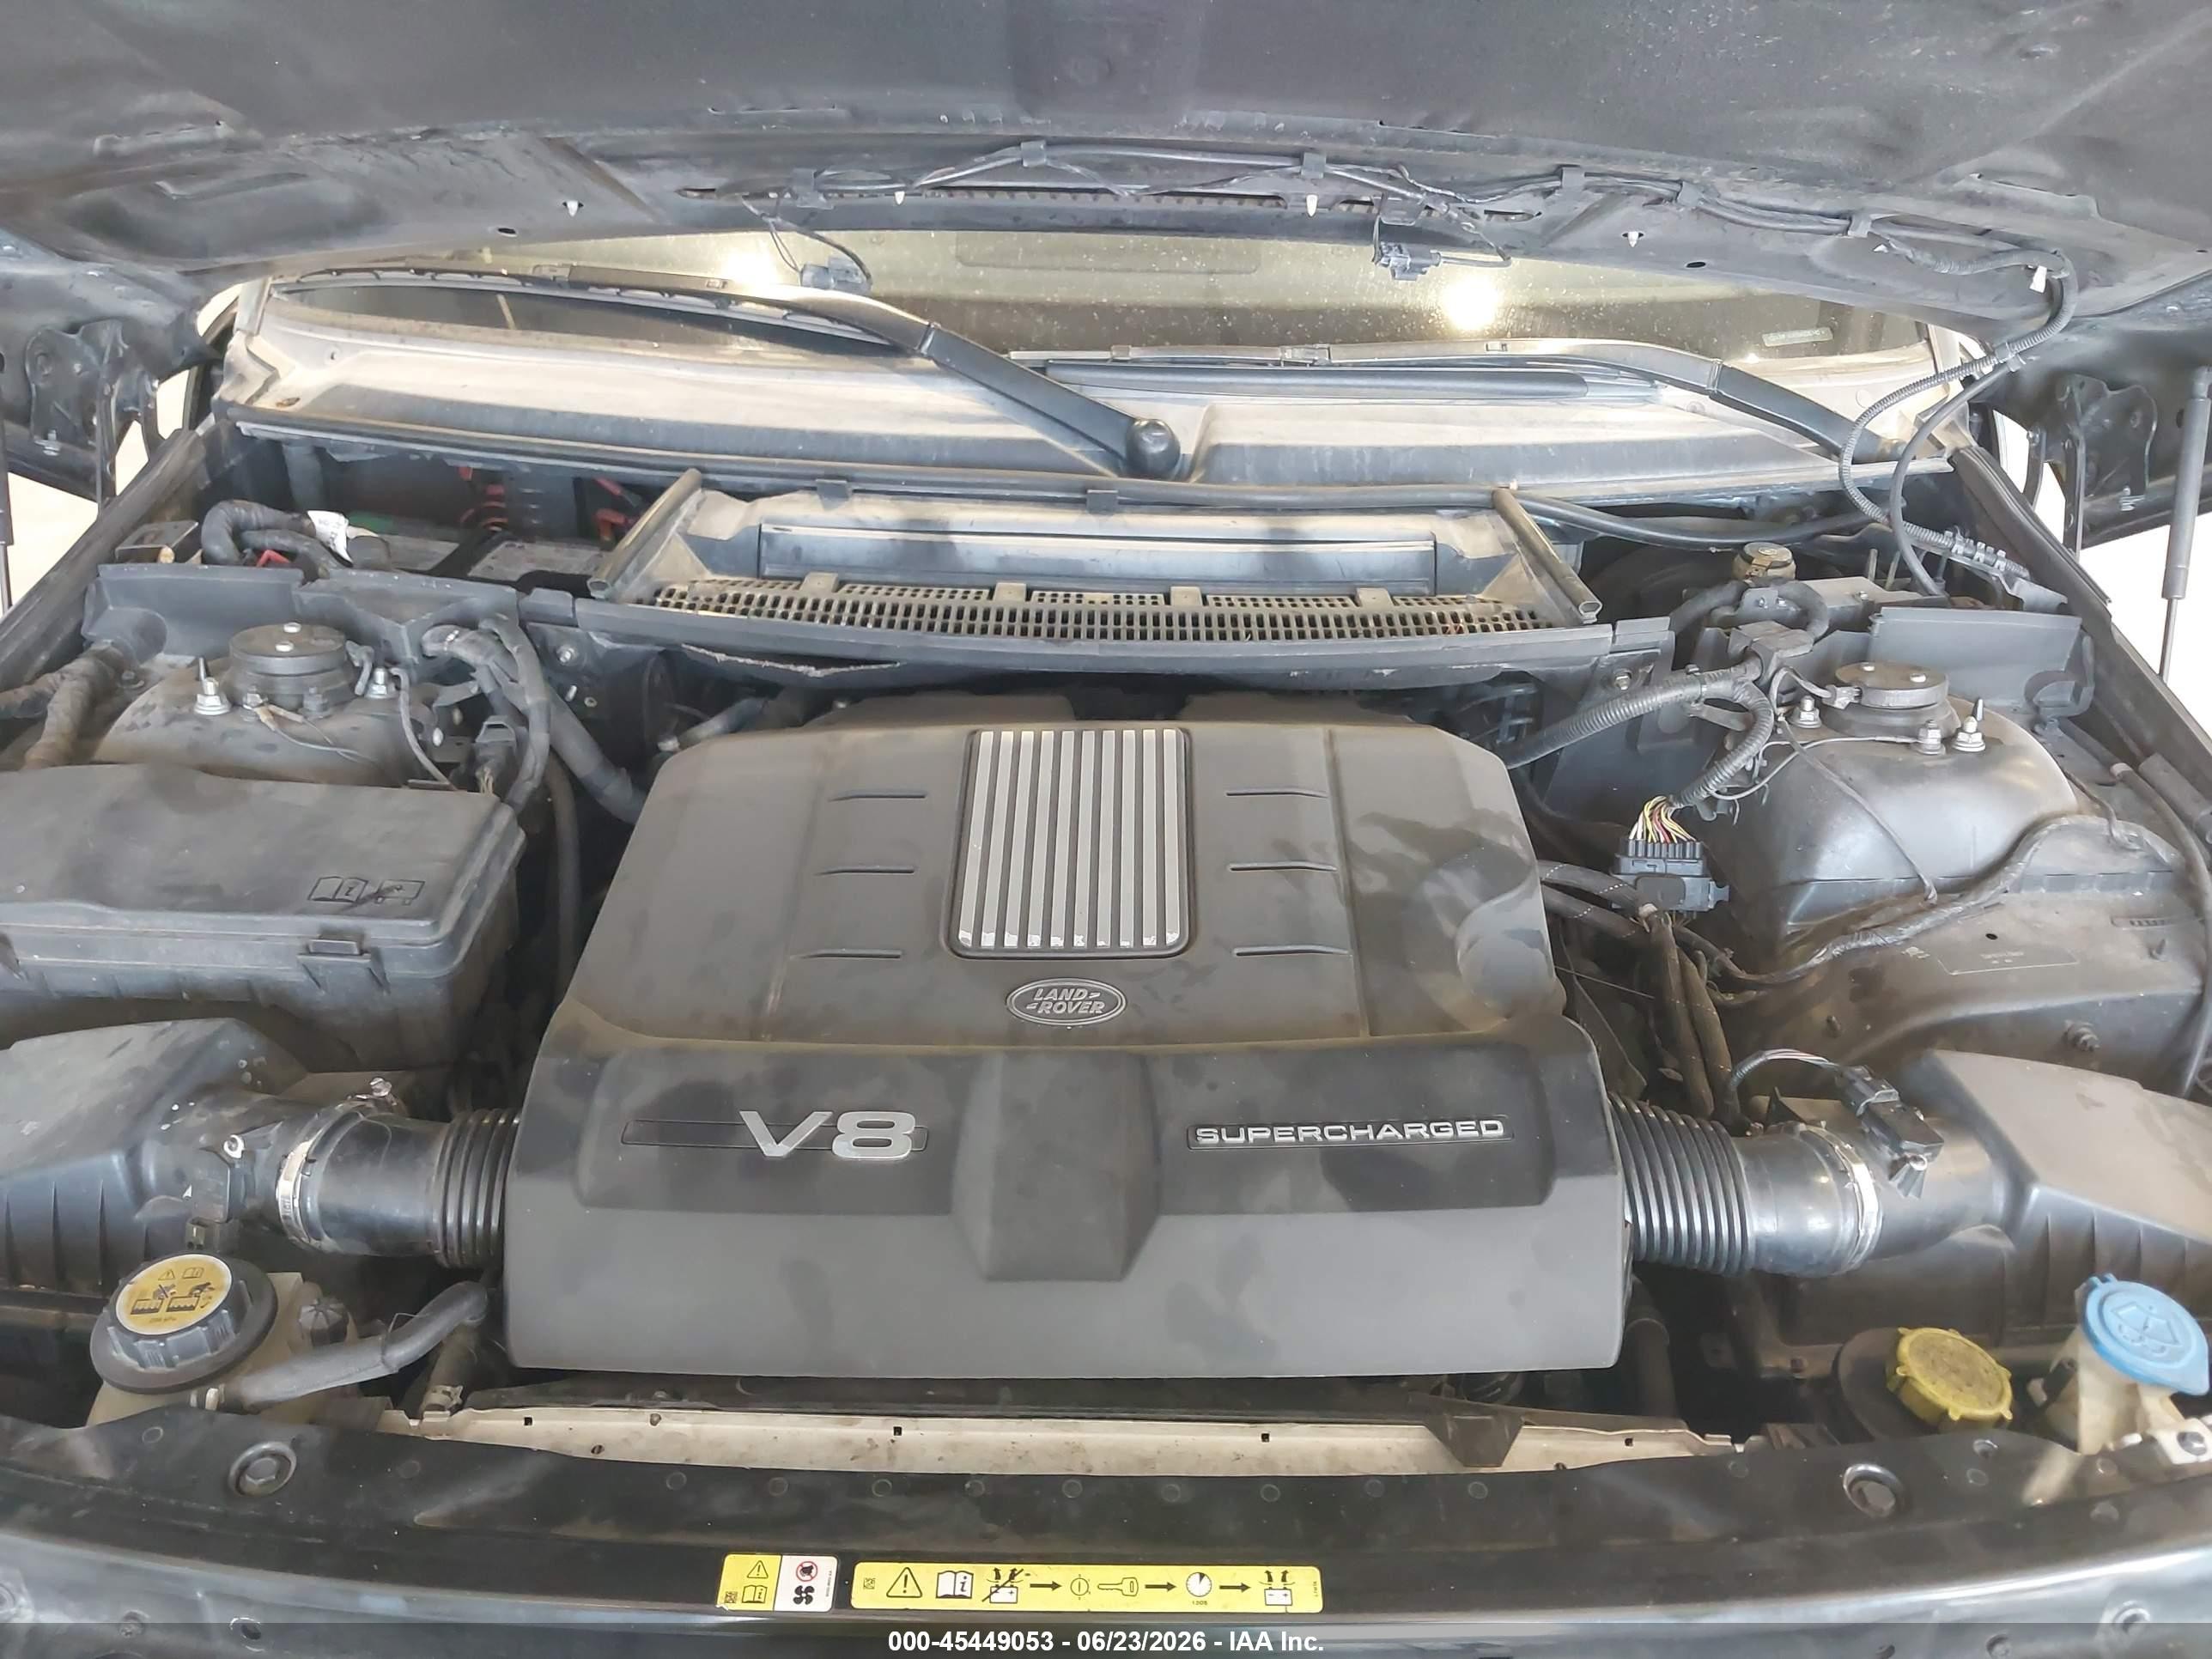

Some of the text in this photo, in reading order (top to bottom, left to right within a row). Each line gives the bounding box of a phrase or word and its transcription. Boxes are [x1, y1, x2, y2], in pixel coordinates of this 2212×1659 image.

[1037, 1000, 1106, 1014] ROVER
[738, 1110, 916, 1159] V8
[1195, 1119, 1504, 1144] SUPERCHARGED
